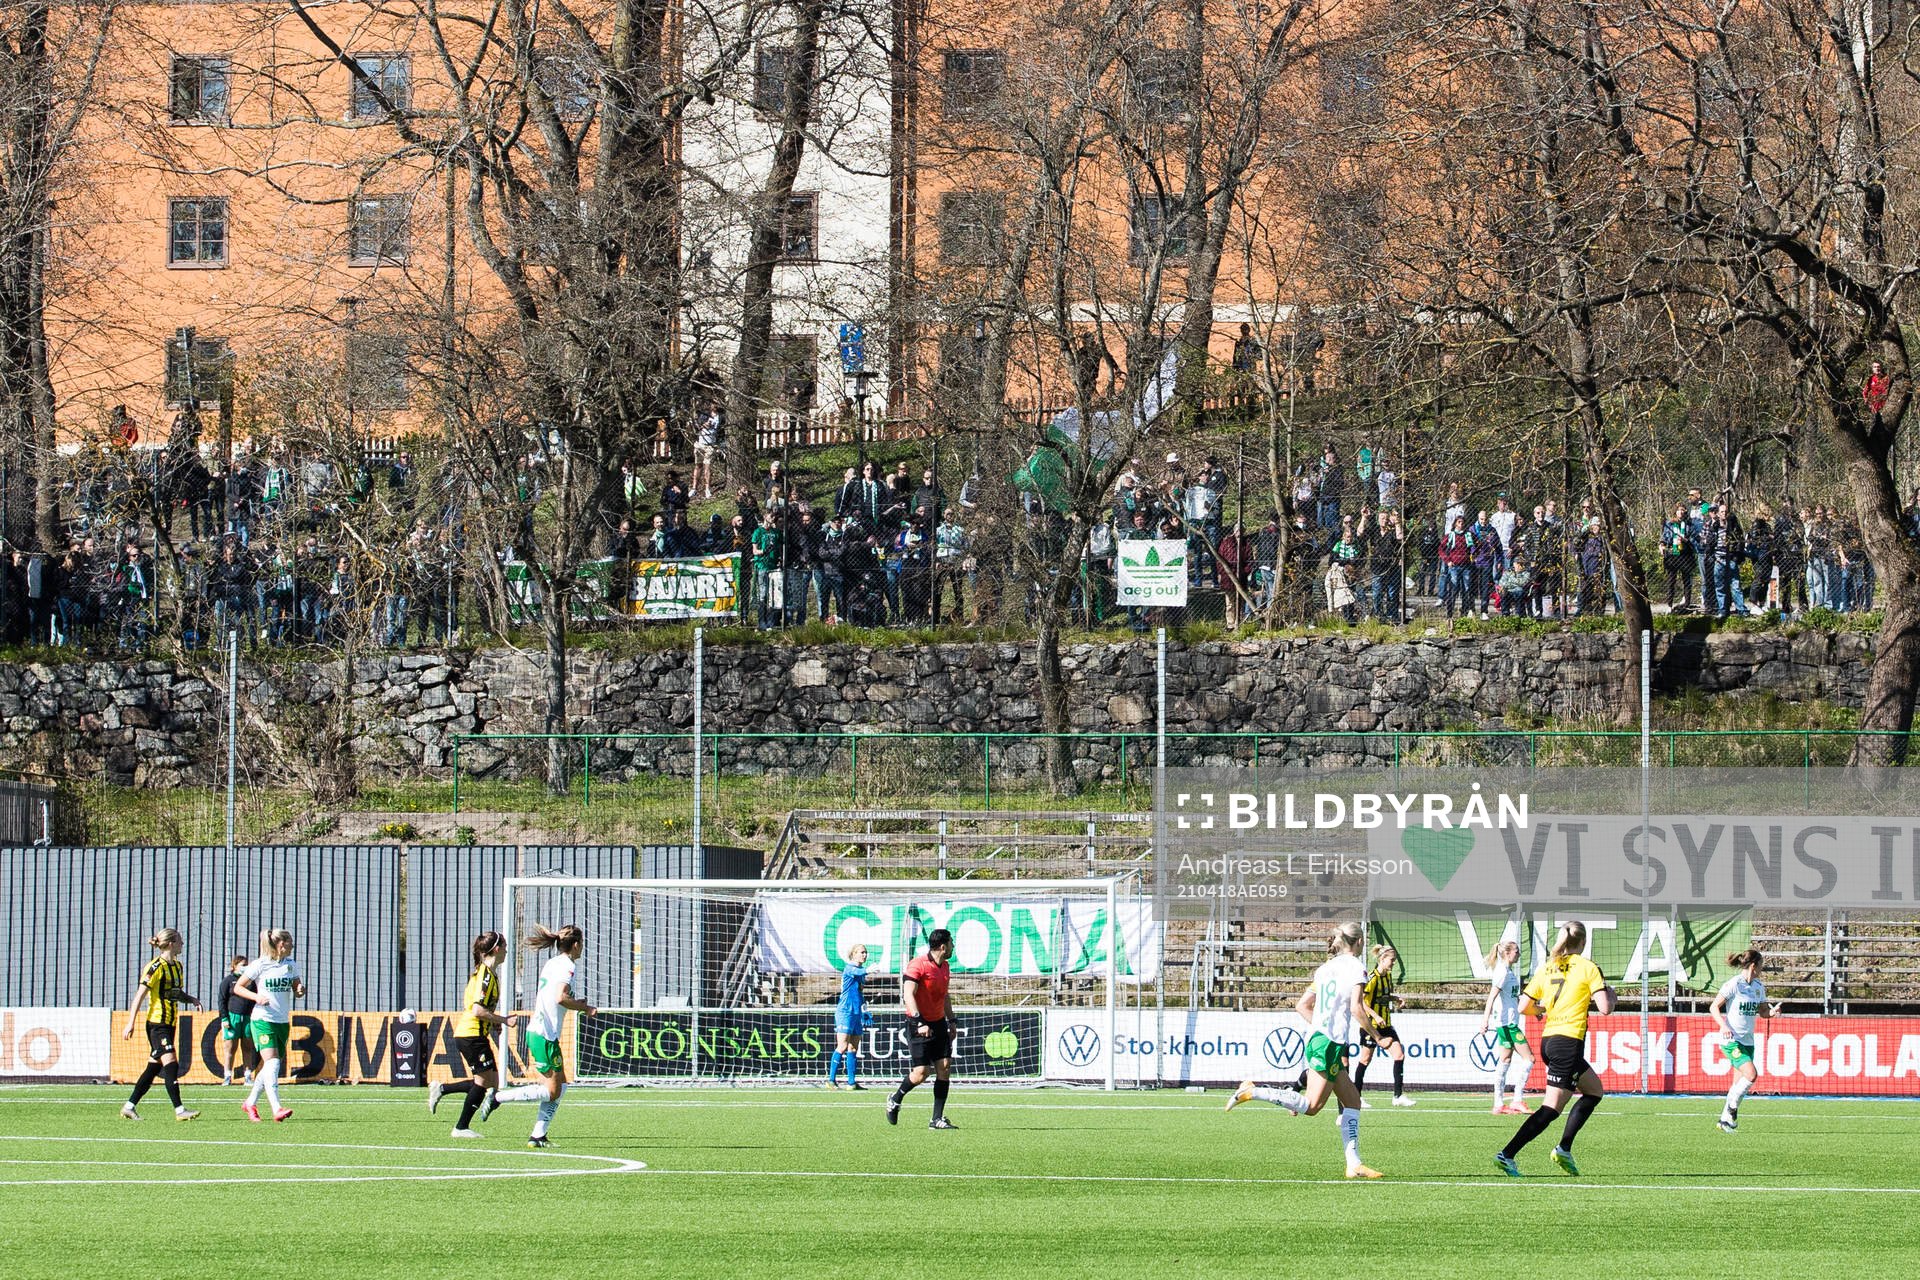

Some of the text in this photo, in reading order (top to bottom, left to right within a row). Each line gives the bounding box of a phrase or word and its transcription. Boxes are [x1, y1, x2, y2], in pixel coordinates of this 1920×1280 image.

[1124, 585, 1179, 598] aeg out
[1500, 822, 1920, 901] VI SYNS I
[823, 899, 1134, 975] GRÖNA
[1453, 908, 1690, 983] VITA
[1320, 979, 1337, 1014] 18
[1551, 977, 1566, 1009] 7
[599, 1020, 821, 1060] GRÖNSAKS
